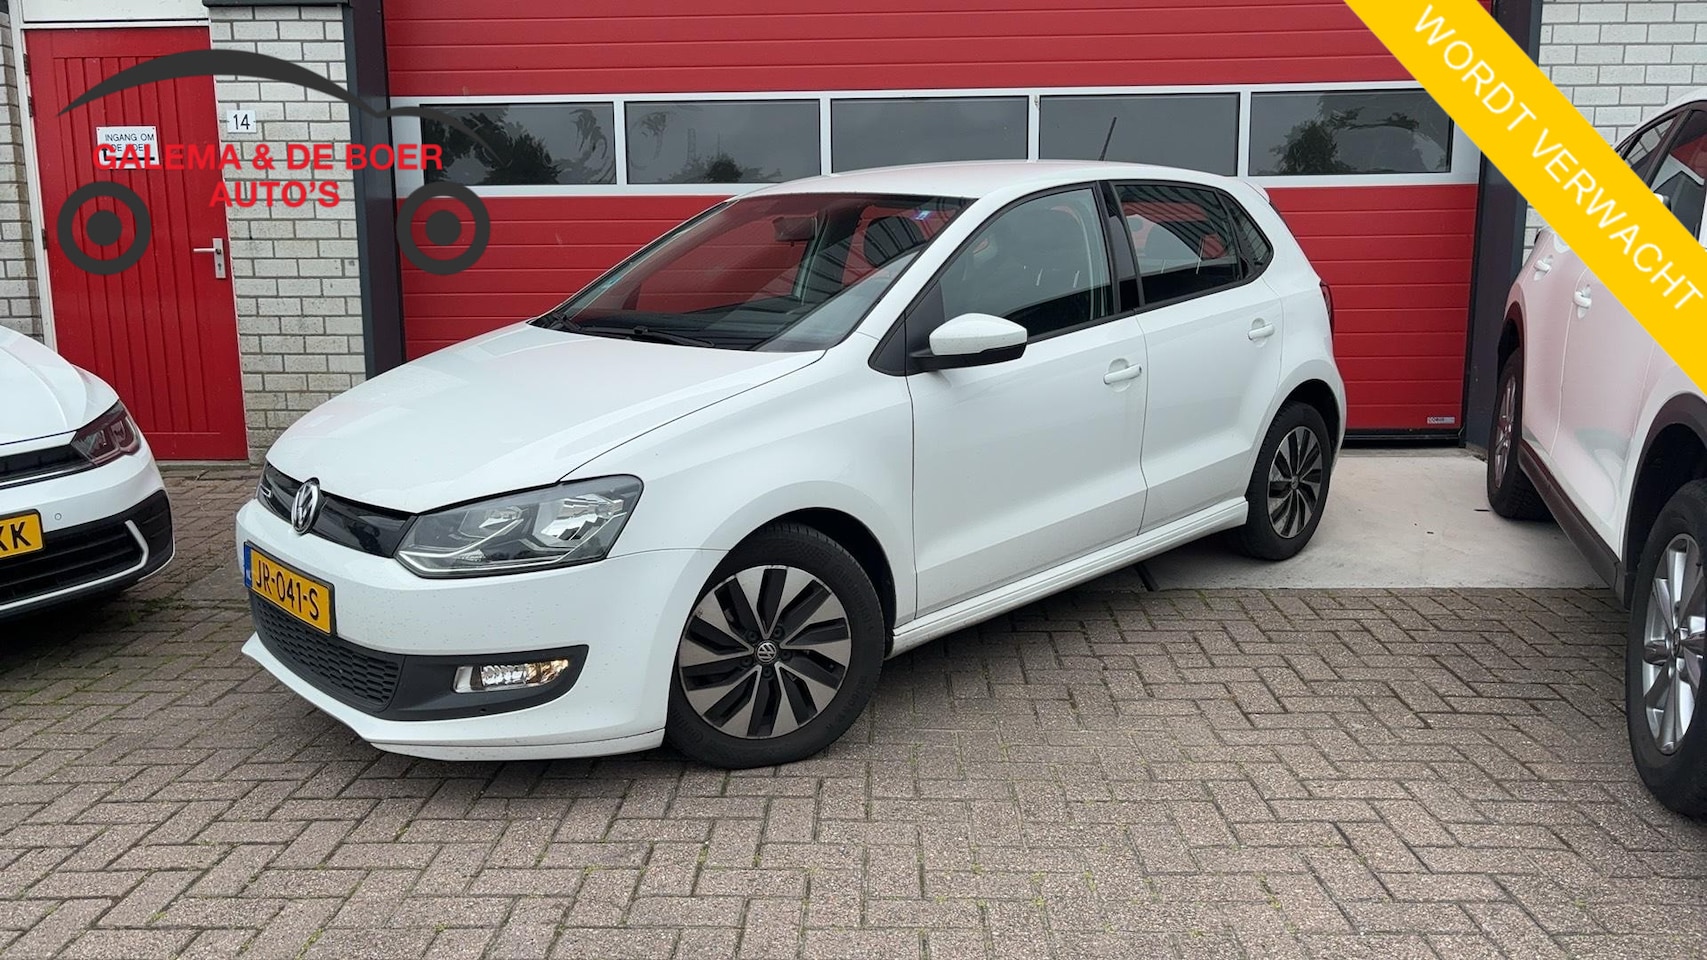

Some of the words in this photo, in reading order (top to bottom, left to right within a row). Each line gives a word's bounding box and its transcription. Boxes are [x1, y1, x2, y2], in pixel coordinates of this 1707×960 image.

[233, 114, 250, 130] 14
[105, 133, 137, 142] INGANG
[140, 133, 155, 141] OM
[256, 560, 319, 621] JR-041-S
